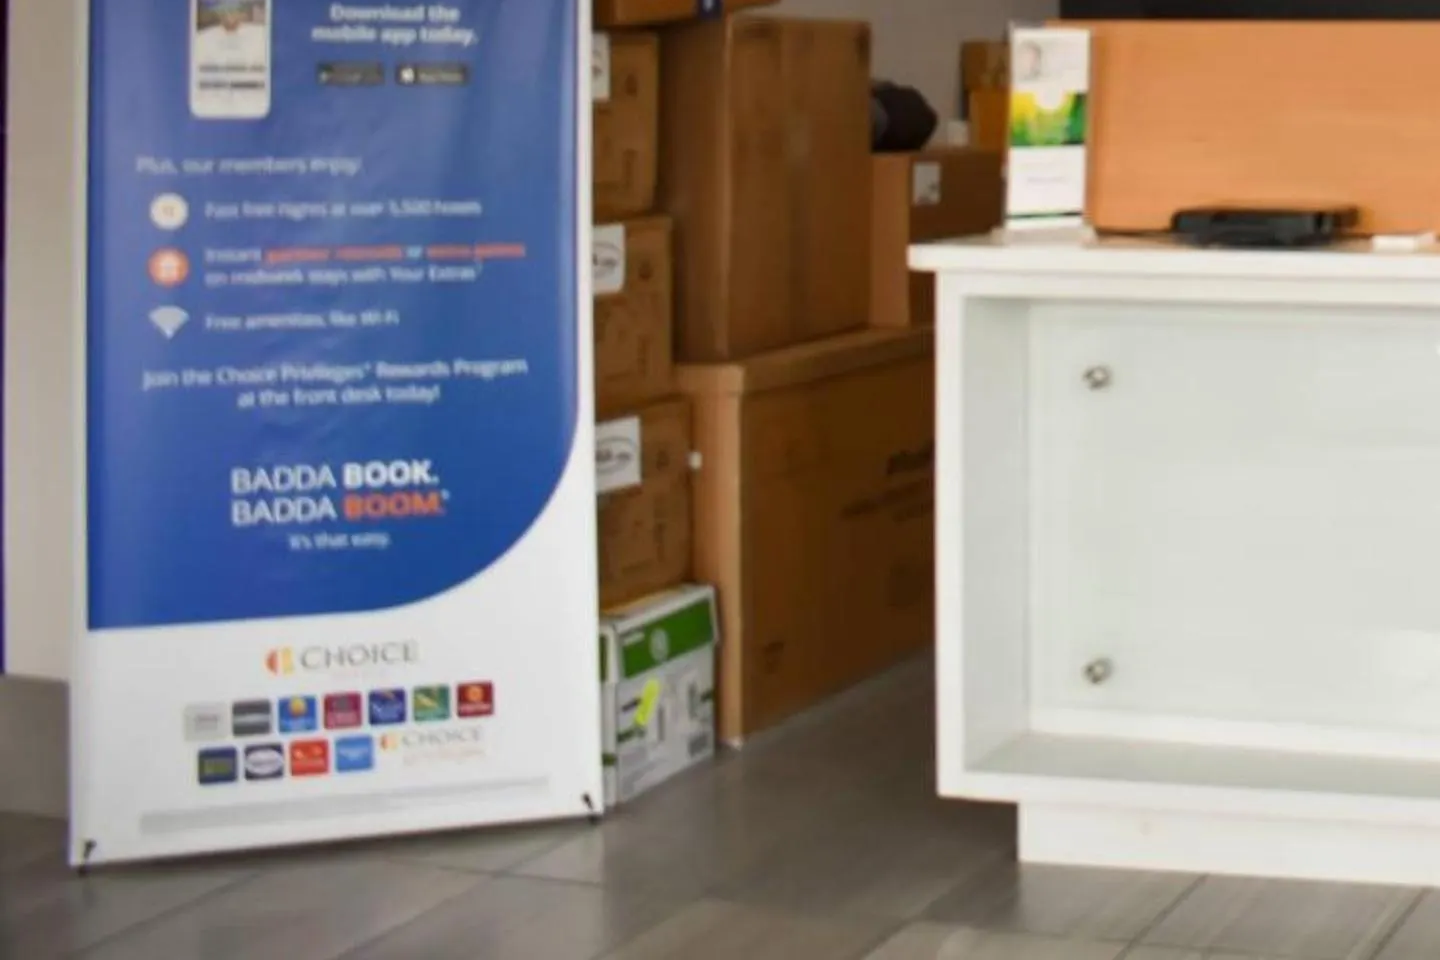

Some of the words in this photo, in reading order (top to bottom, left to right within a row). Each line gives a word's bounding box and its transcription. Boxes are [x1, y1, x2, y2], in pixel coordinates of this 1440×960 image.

[330, 2, 425, 22] Download
[427, 4, 461, 23] the
[311, 25, 376, 43] mobile
[380, 28, 417, 47] app
[142, 370, 179, 391] Join
[181, 367, 213, 385] the
[215, 365, 277, 385] Choice
[453, 357, 529, 382] Program
[237, 391, 256, 408] at
[258, 388, 290, 406] the
[293, 387, 338, 405] front
[341, 385, 382, 404] desk
[231, 463, 337, 494] BADDA
[342, 458, 440, 488] BOOK.
[231, 495, 338, 527] BADDA
[300, 640, 419, 670] CHOICE
